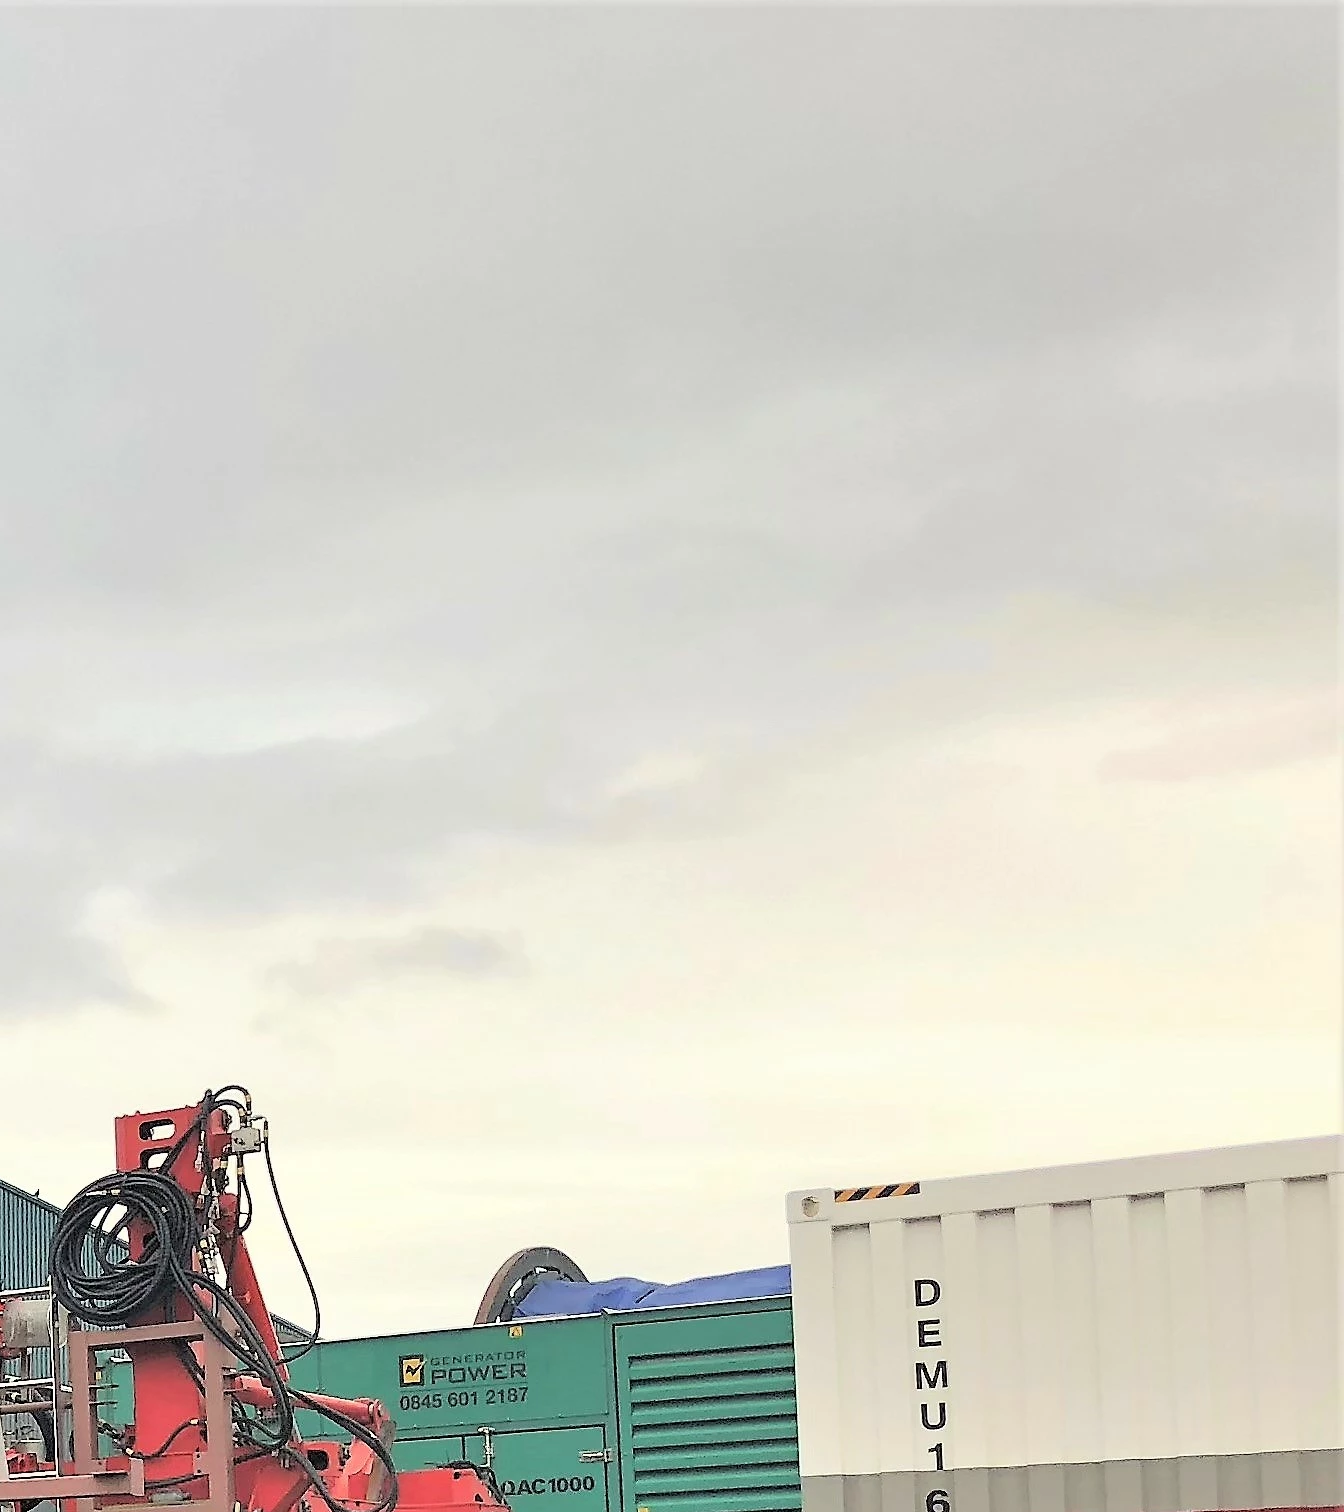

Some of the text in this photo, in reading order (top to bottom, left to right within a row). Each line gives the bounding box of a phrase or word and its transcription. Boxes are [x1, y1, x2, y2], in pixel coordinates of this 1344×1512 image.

[431, 1350, 526, 1366] GENERATOR
[431, 1362, 527, 1385] POWER
[399, 1386, 529, 1411] 0845 601 2187
